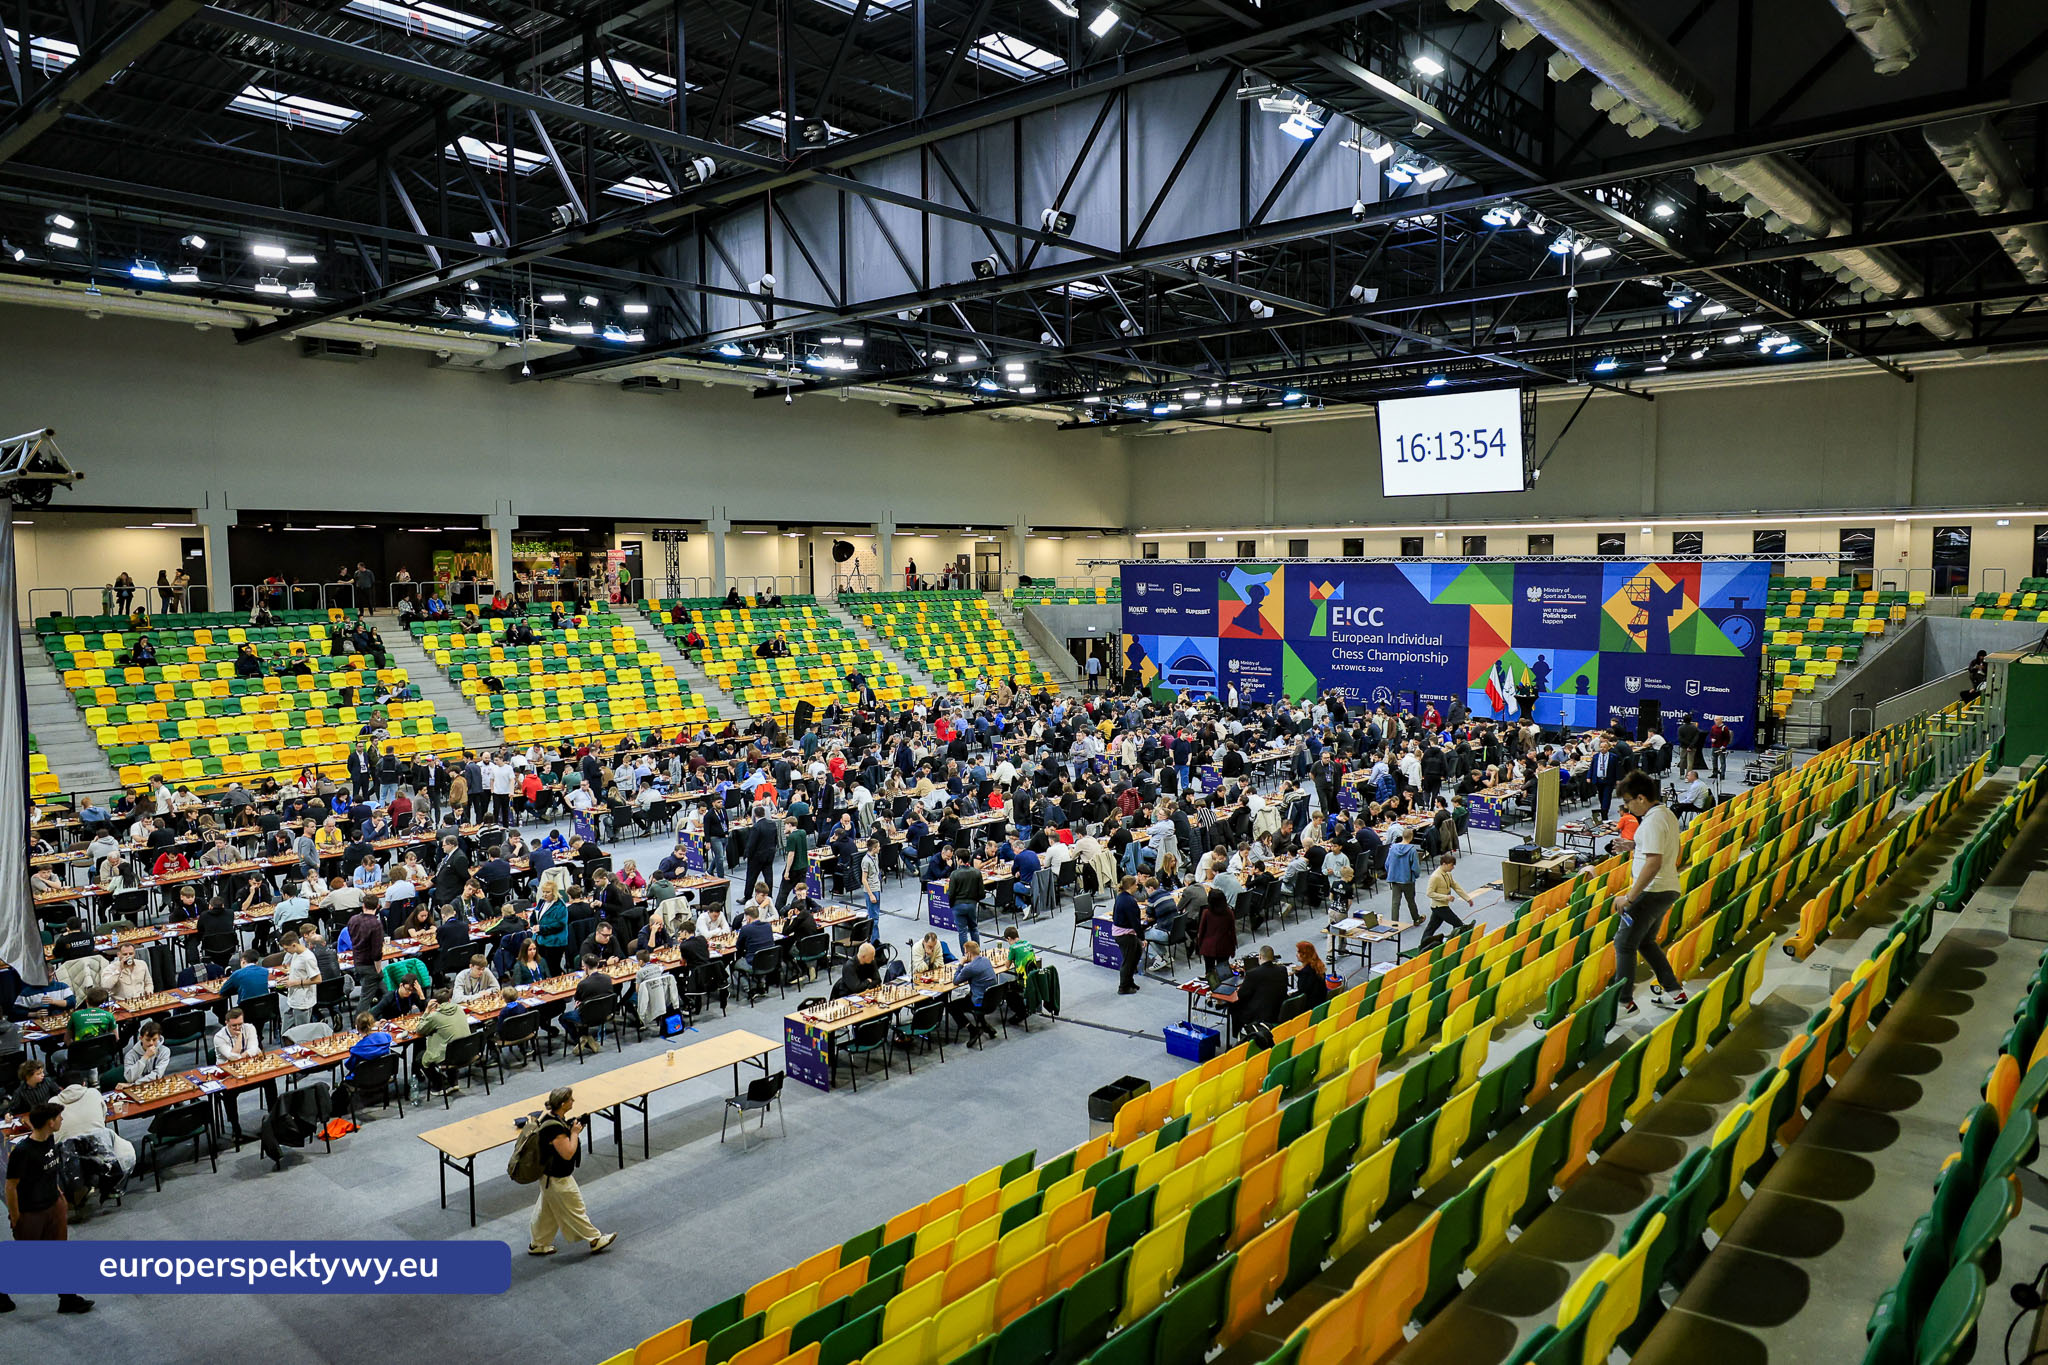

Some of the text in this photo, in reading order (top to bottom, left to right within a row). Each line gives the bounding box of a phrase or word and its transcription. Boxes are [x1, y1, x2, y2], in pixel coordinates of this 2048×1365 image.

[1396, 427, 1507, 463] 16:13:54
[1332, 631, 1443, 646] European Individual
[1331, 647, 1449, 667] Chess Championship
[1331, 664, 1367, 672] KATOWICE
